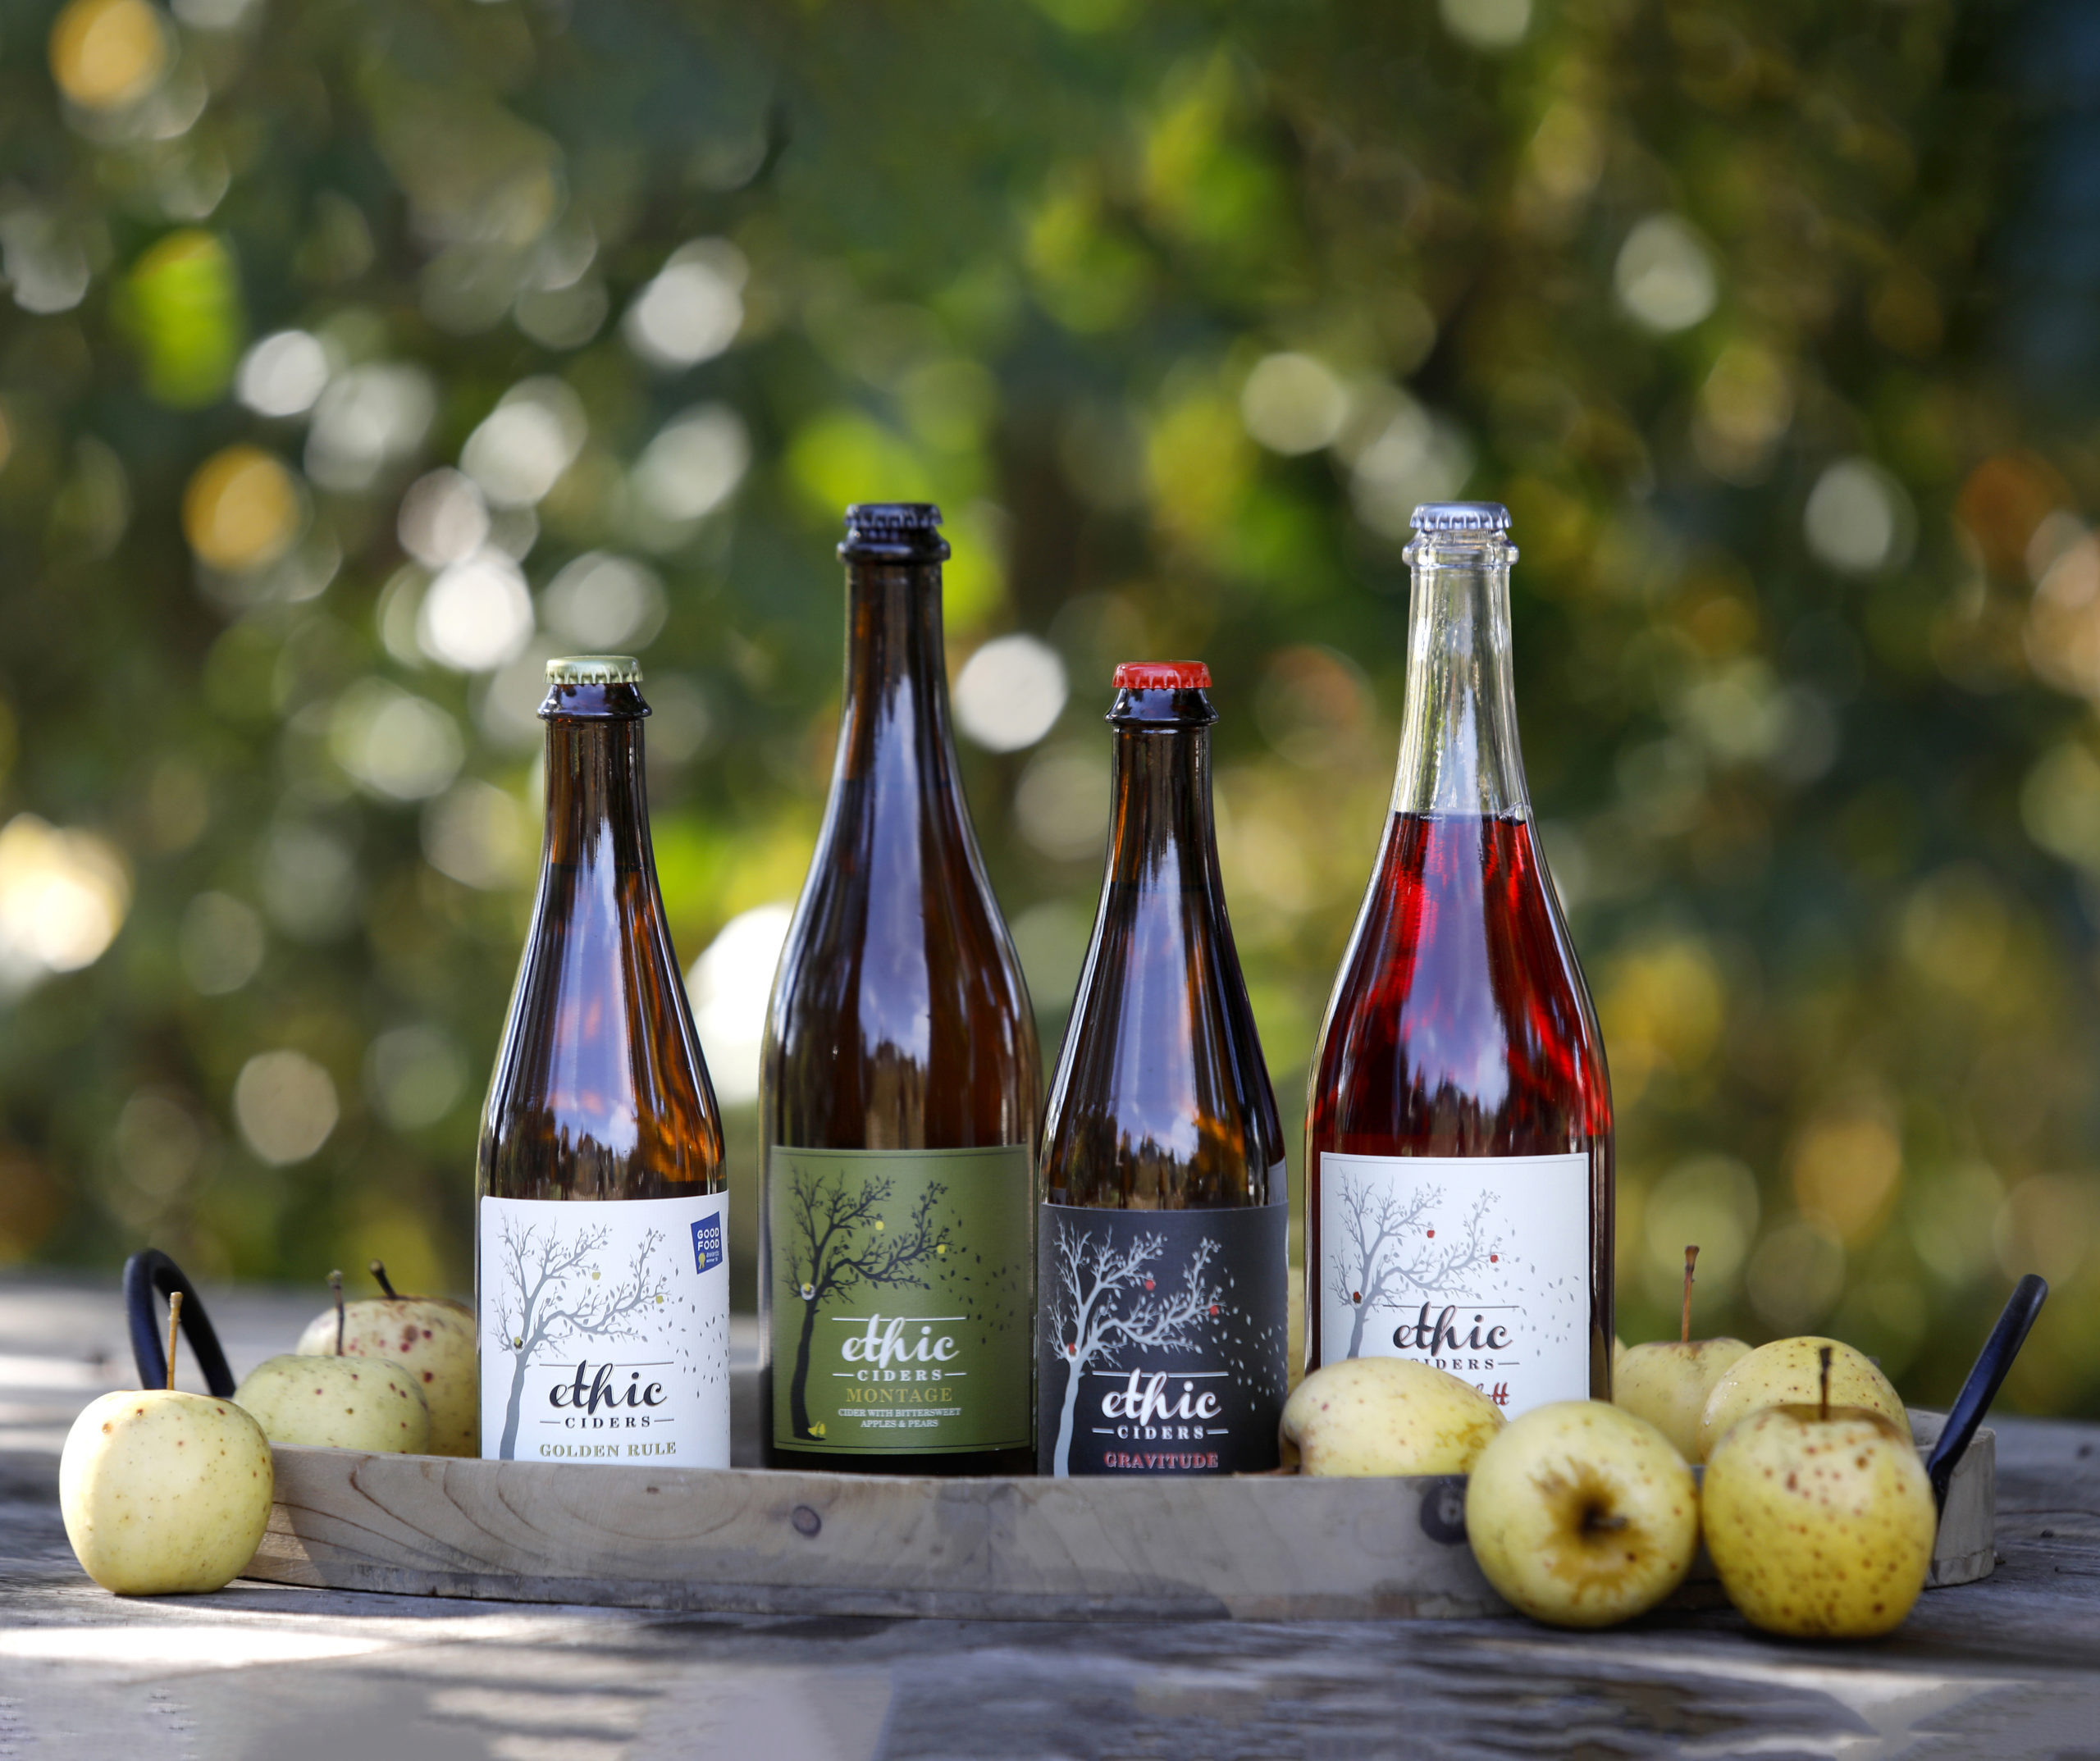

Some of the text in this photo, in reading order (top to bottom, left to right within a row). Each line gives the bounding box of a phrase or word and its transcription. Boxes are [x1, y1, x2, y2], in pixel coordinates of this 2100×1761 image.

[696, 1227, 719, 1240] GOOD
[697, 1239, 719, 1252] FOOD
[1393, 1302, 1513, 1357] ethic
[842, 1313, 961, 1369] ethic
[856, 1369, 943, 1381] CIDERS
[549, 1359, 668, 1416] ethic
[846, 1387, 952, 1403] MONTAGE
[1101, 1366, 1222, 1427] ethic
[838, 1407, 961, 1417] CIDER WITH BITTERSWEET
[565, 1416, 651, 1429] CIDERS
[860, 1419, 938, 1428] APPLES & PEARS
[1116, 1425, 1204, 1439] CIDERS
[539, 1441, 677, 1458] GOLDEN RULE
[1103, 1451, 1219, 1469] GRAVITUDE
